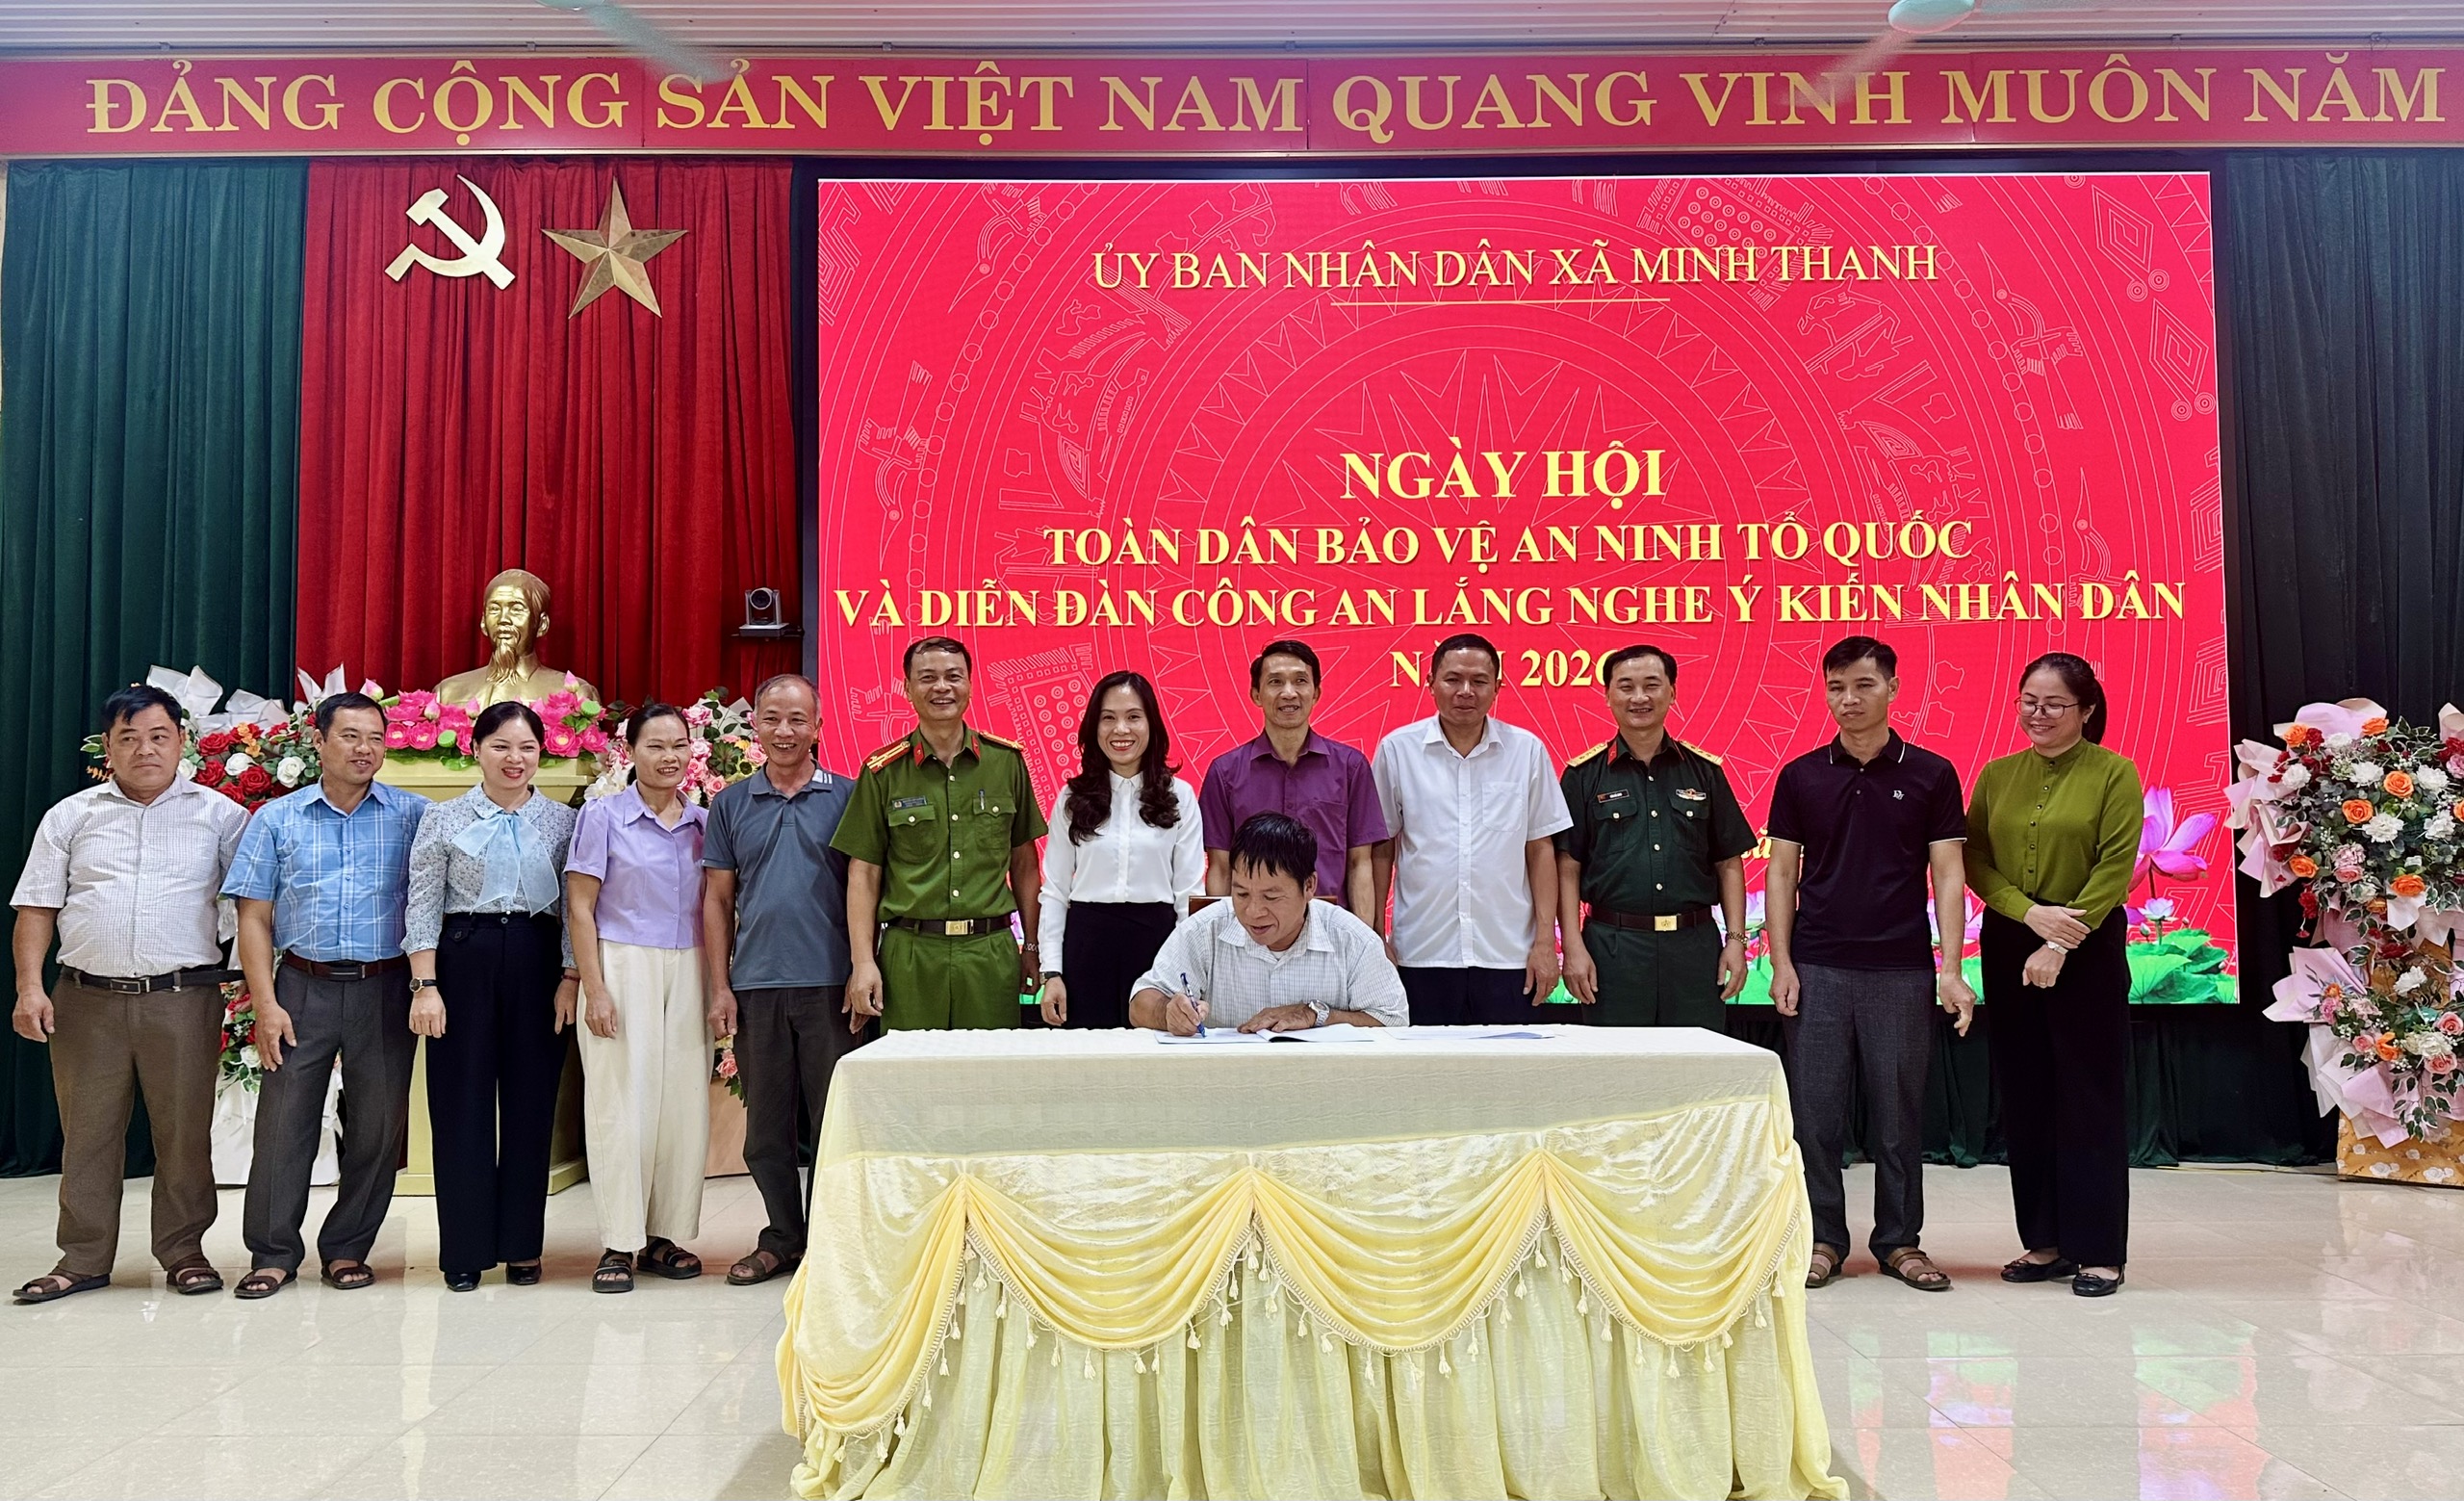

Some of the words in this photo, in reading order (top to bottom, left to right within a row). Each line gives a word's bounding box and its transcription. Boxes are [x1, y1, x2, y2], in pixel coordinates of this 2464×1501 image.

[86, 59, 346, 134] ĐẢNG
[372, 60, 629, 146] CỘNG
[655, 58, 834, 131] SẢN
[859, 61, 1075, 146] VIỆT
[1098, 76, 1305, 133] NAM
[1331, 72, 1656, 144] QUANG
[1679, 70, 1913, 127] VINH
[1938, 53, 2218, 125] MUÔN
[2243, 51, 2448, 123] NĂM
[1092, 241, 1161, 290] ỦY
[1173, 251, 1269, 289] BAN
[1282, 240, 1422, 288] NHÂN
[1433, 238, 1535, 286] DÂN
[1550, 240, 1618, 285] XÃ
[1631, 246, 1758, 284] MINH
[1770, 245, 1938, 282] THANH
[1340, 436, 1527, 500] NGÀY
[1545, 440, 1665, 509] HỘI
[1042, 517, 1181, 566] TOÀN
[1196, 515, 1299, 565] DÂN
[1316, 517, 1420, 564] BẢO
[1433, 526, 1499, 574] VỆ
[1510, 526, 1578, 563] AN
[1593, 524, 1724, 562] NINH
[1736, 511, 1811, 561] TỔ
[1822, 510, 1973, 561] QUỐC
[834, 579, 903, 628] VÀ
[919, 579, 1040, 628] DIỄN
[1053, 579, 1158, 627] ĐÀN
[1170, 578, 1318, 627] CÔNG
[1329, 588, 1397, 626] AN
[1412, 575, 1553, 626] LẮNG
[1568, 585, 1714, 624] NGHE
[1728, 574, 1760, 623] Ý
[1778, 568, 1904, 623] KIẾN
[1918, 570, 2066, 622] NHÂN
[2080, 569, 2186, 621] DÂN
